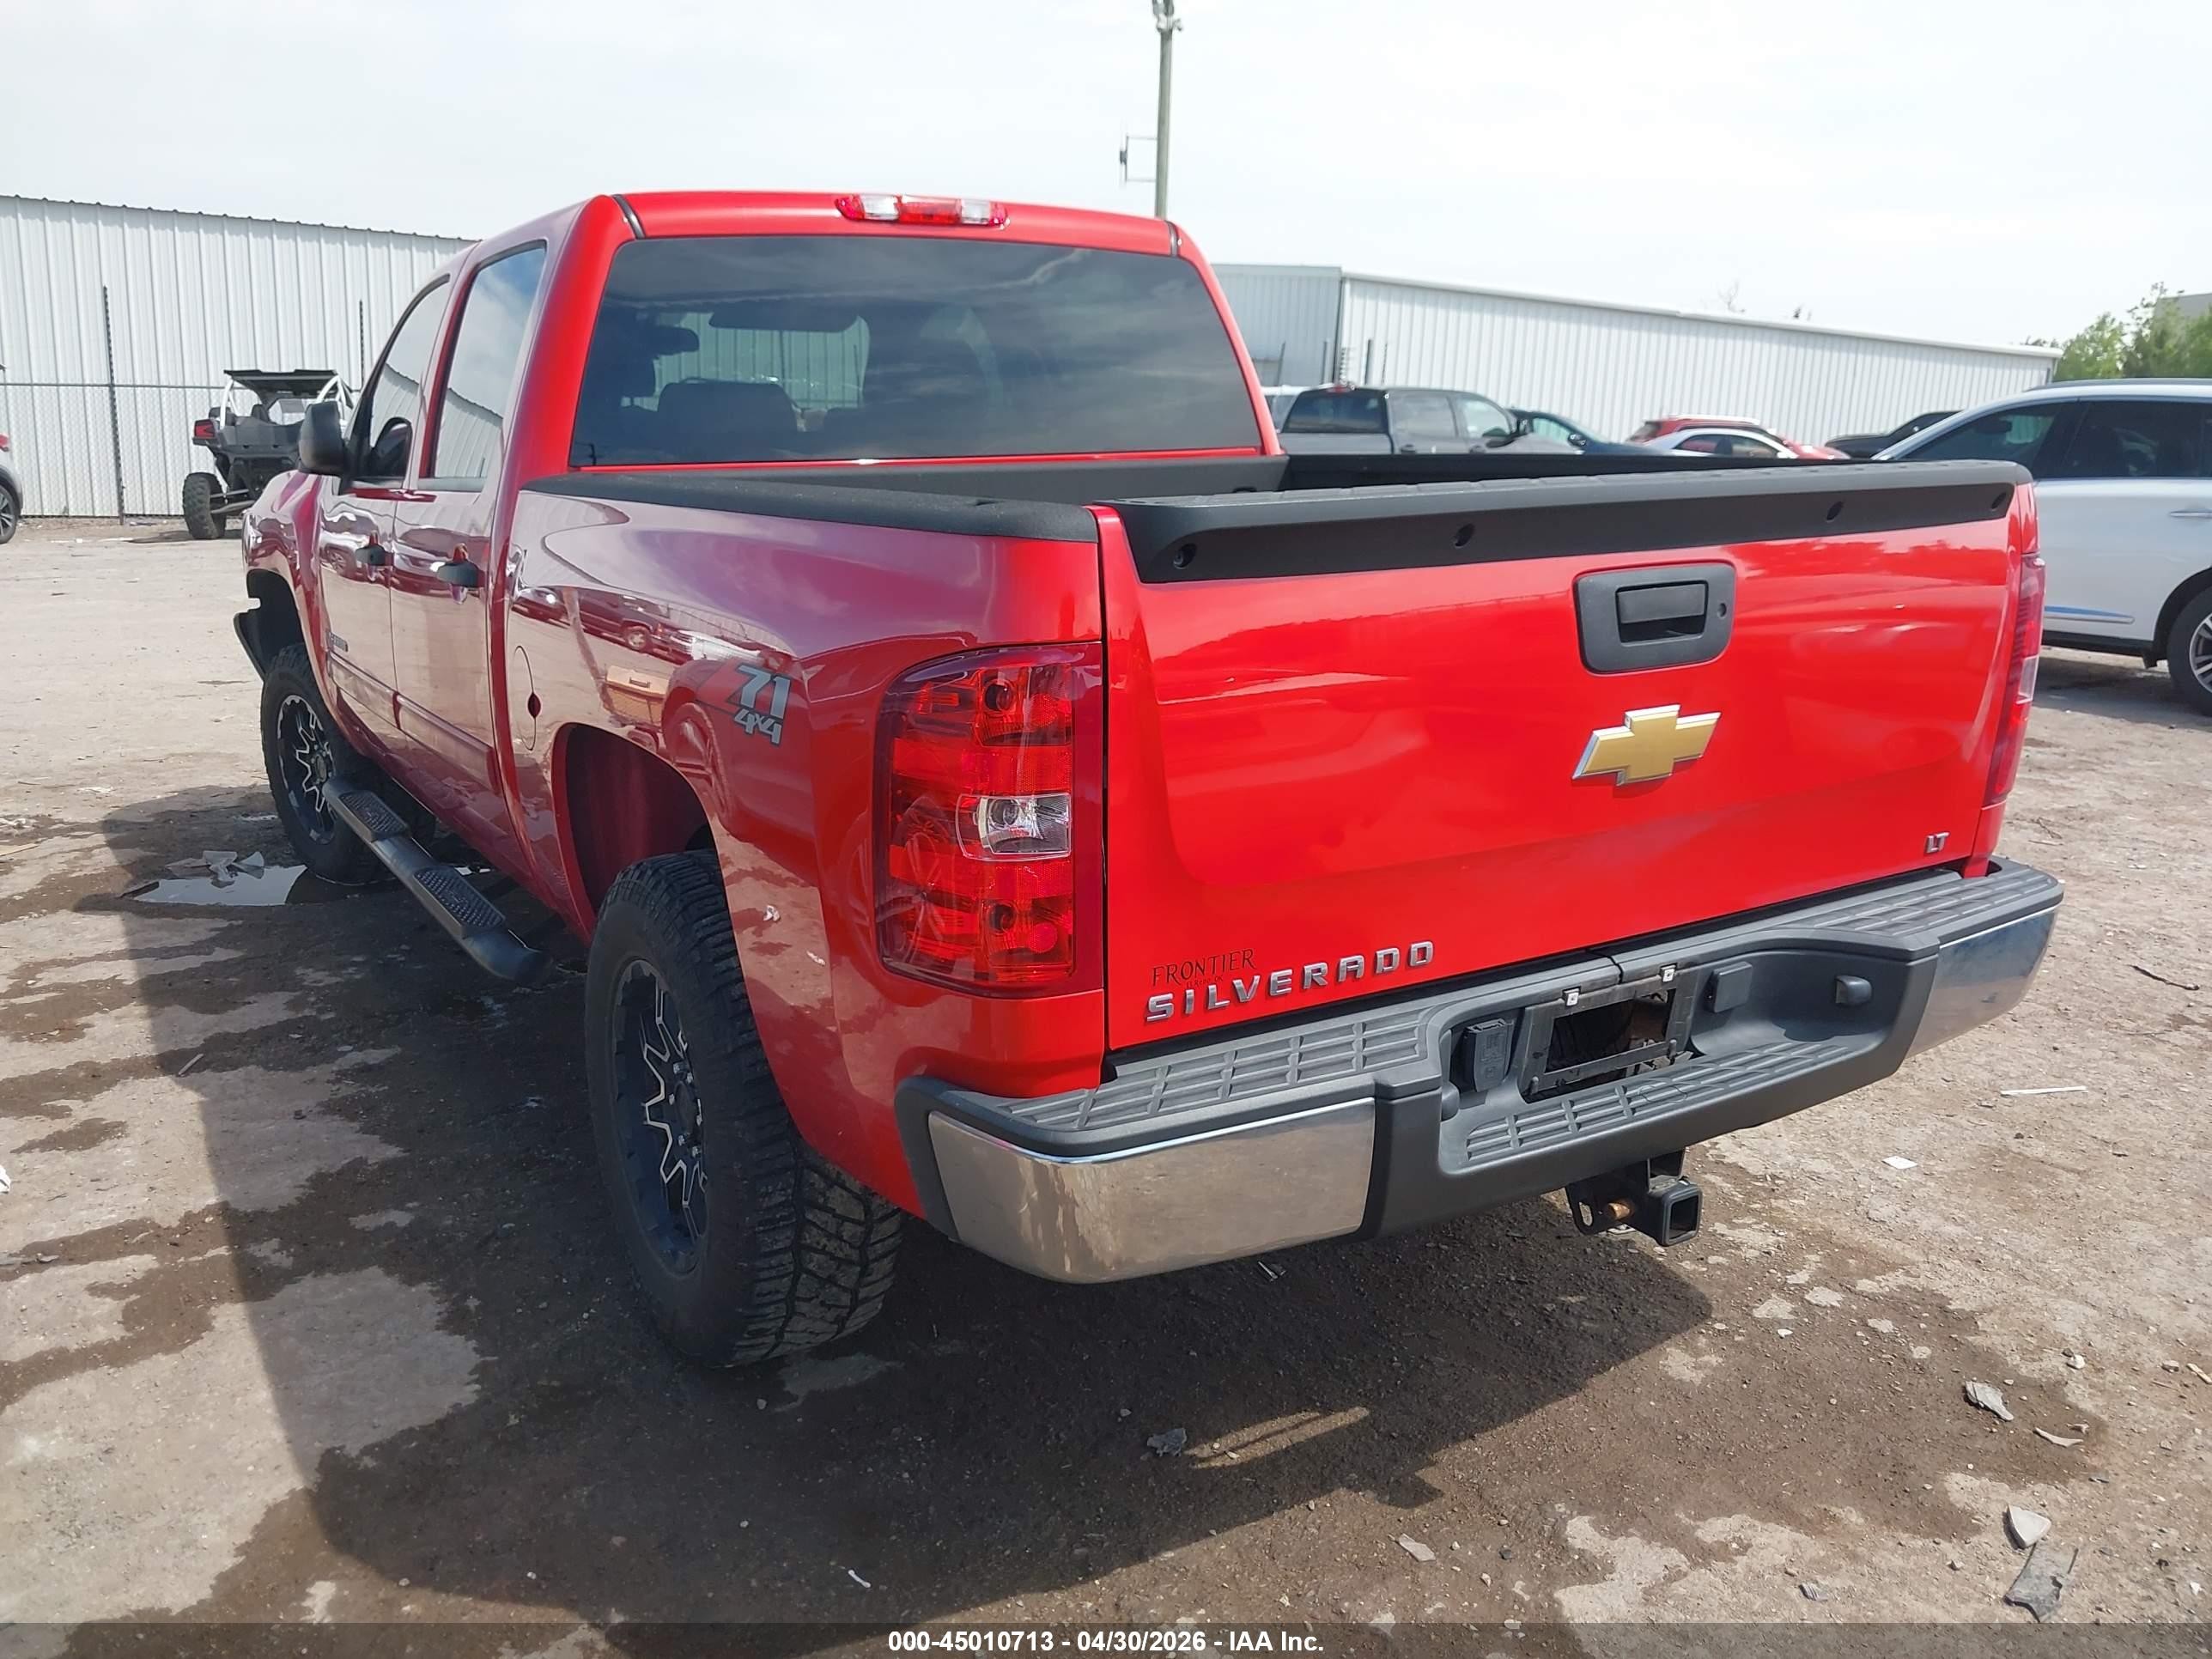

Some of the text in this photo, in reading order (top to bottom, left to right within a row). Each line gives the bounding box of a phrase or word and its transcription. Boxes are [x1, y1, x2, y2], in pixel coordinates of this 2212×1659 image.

[1925, 831, 1950, 854] LT
[1146, 940, 1434, 1022] SILVERADO
[1152, 948, 1257, 987] FRONTIER
